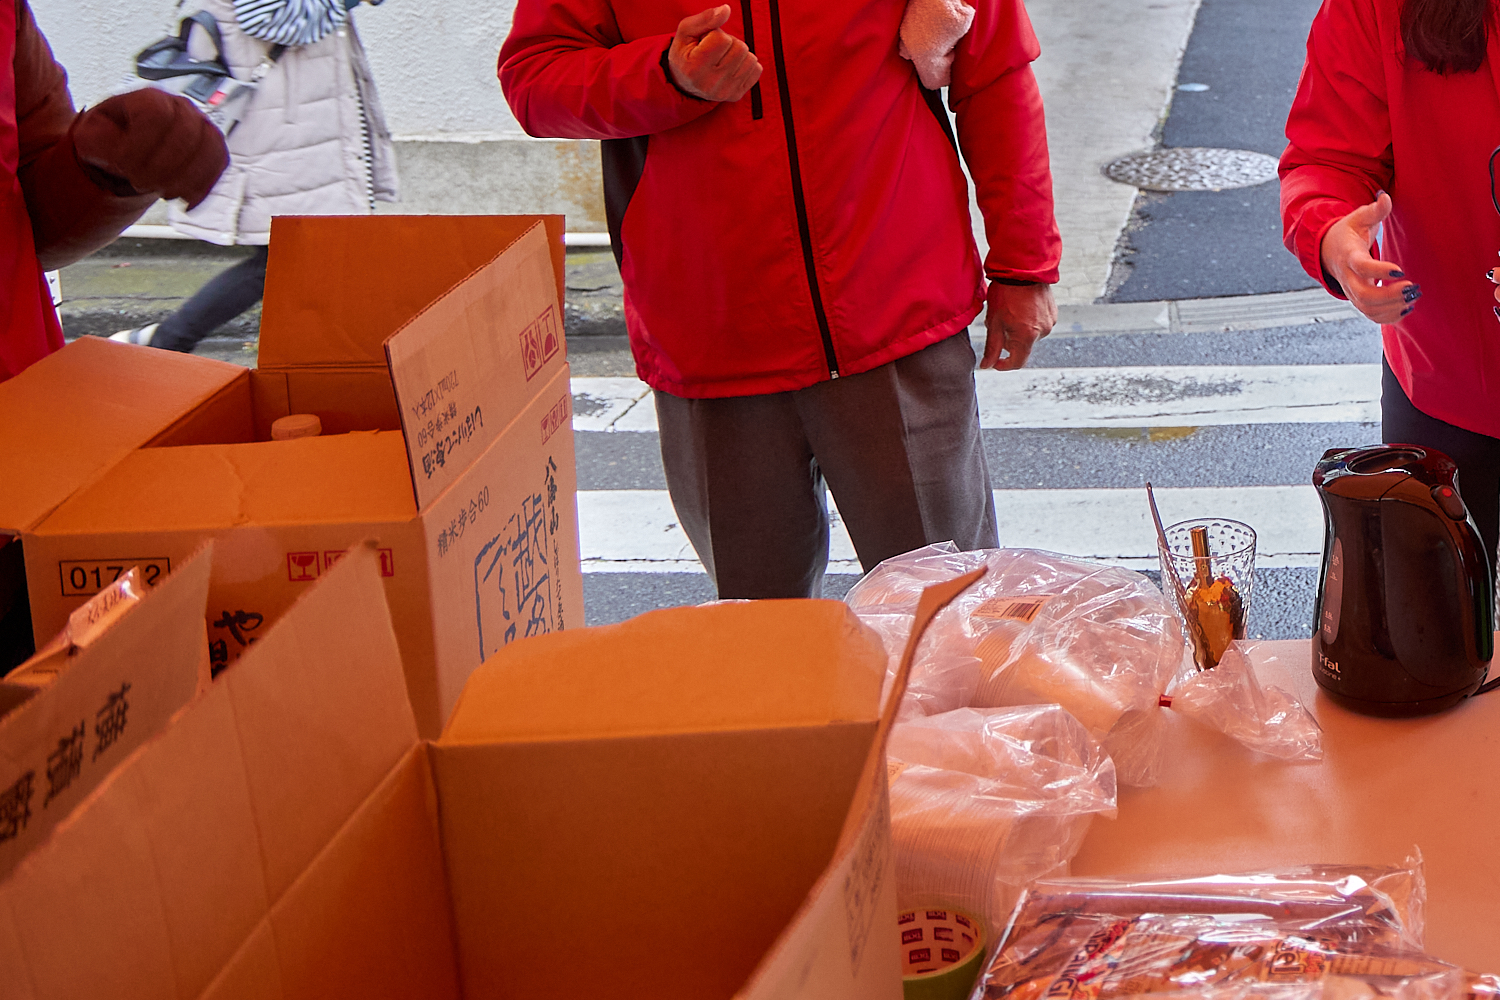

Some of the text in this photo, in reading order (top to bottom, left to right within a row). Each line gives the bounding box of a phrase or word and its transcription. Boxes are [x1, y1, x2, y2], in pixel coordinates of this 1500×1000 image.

[437, 485, 491, 559] 精米歩合60
[69, 564, 162, 591] 0172
[1317, 651, 1342, 674] T-fal
